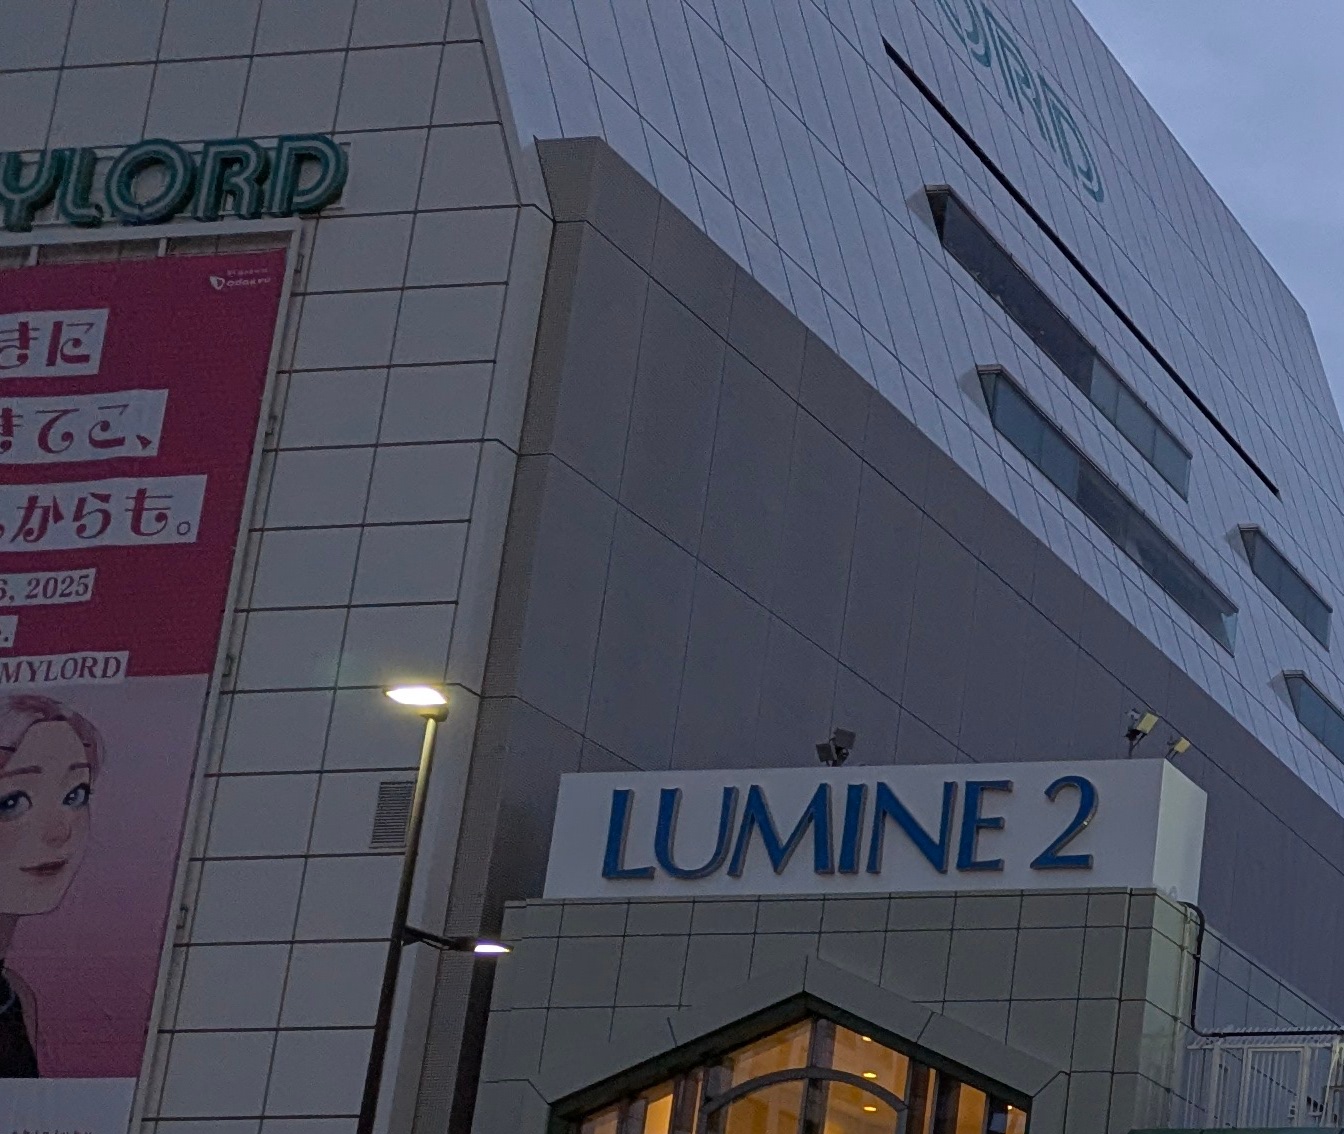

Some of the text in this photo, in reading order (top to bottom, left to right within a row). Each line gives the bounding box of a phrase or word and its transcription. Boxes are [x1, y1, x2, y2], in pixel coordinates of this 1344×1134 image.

[0, 487, 191, 544] からも。
[25, 573, 90, 600] 2025
[601, 775, 1098, 881] LUMINE 2
